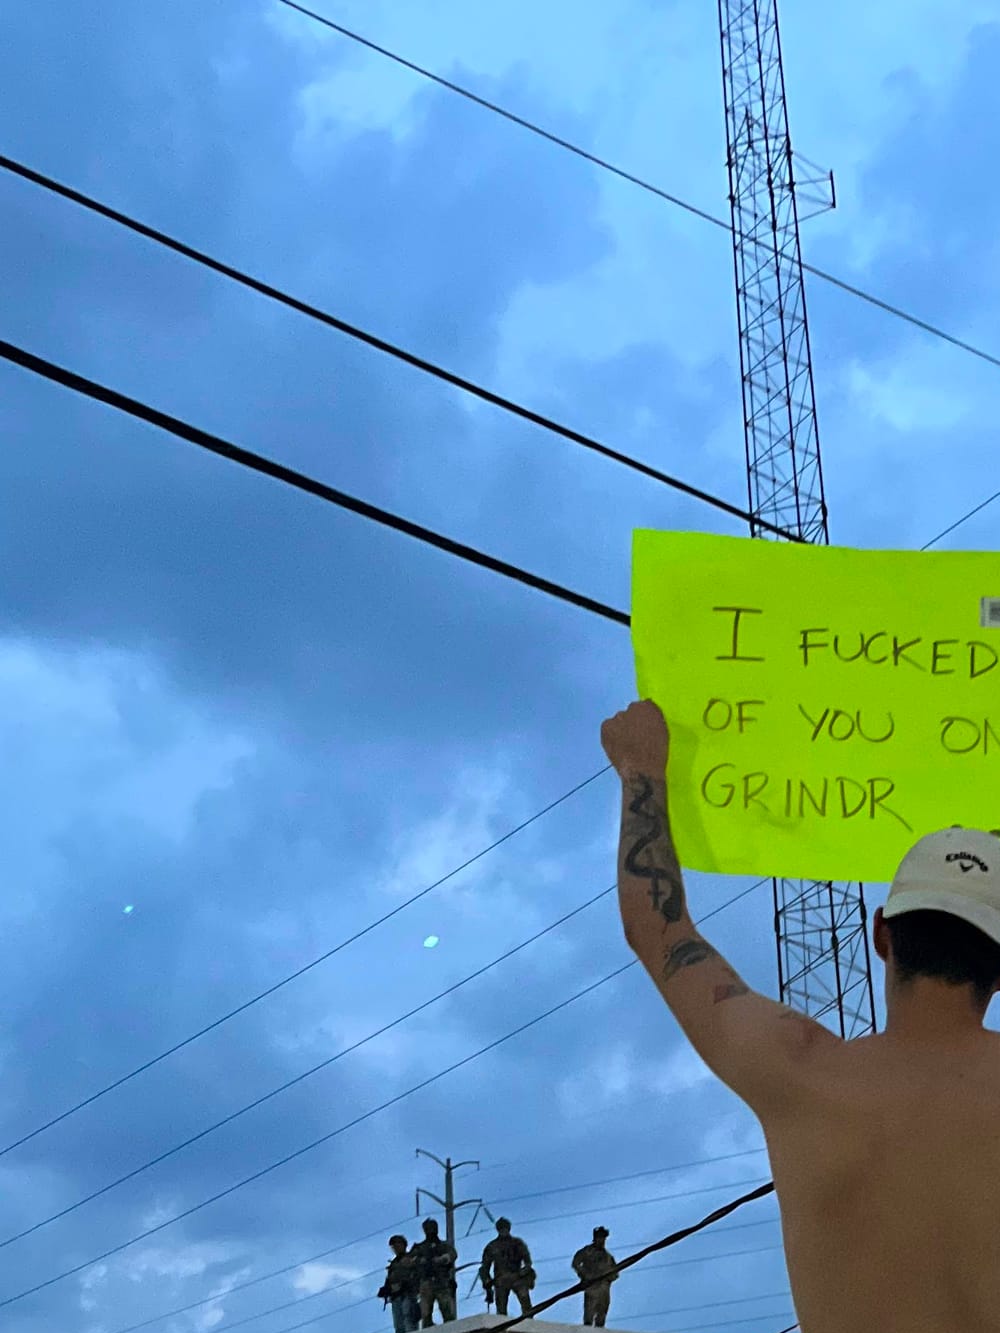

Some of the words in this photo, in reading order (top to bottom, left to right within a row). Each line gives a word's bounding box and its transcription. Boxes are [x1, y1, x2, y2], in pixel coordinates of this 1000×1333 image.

[712, 606, 765, 662] I
[799, 627, 999, 678] FUCKED
[703, 698, 766, 733] OF
[798, 703, 895, 743] YOU
[701, 762, 914, 833] GRINDR
